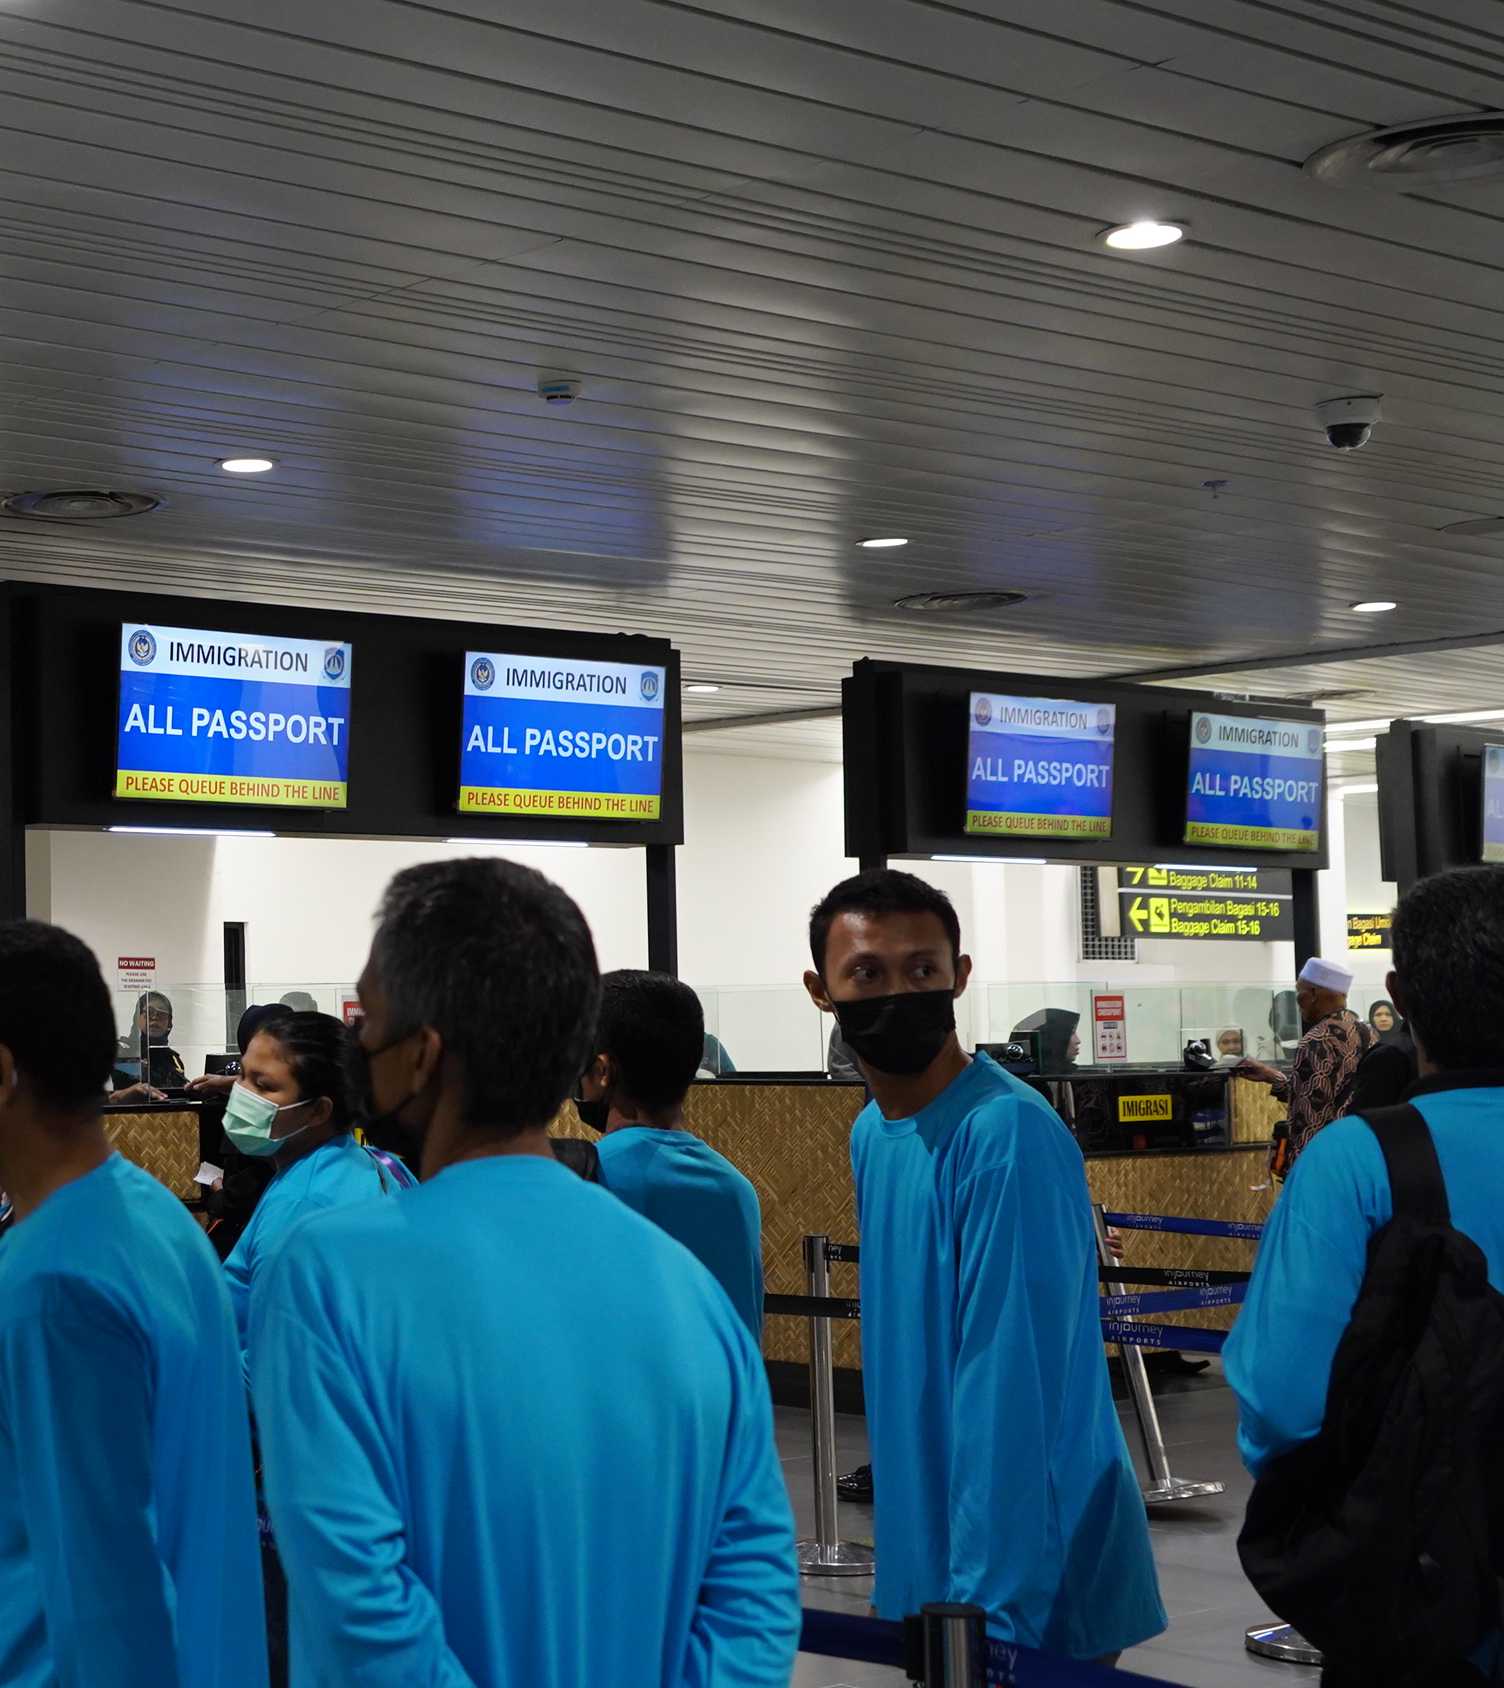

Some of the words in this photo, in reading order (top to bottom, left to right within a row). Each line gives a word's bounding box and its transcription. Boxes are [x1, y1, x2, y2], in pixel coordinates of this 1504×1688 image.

[169, 641, 308, 672] IMMIGRATION
[506, 668, 627, 694] IMMIGRATION
[124, 703, 183, 735] ALL
[191, 707, 344, 746] PASSPORT
[1000, 706, 1087, 729] IMMIGRATION
[467, 725, 517, 754] ALL
[525, 728, 659, 762] PASSPORT
[1219, 725, 1299, 748] IMMIGRATION
[971, 757, 1009, 782] ALL
[1013, 759, 1110, 788] PASSPORT
[126, 776, 175, 793] PLEASE
[178, 779, 226, 796] QUEUE
[230, 782, 280, 798] BEHIND
[284, 784, 308, 799] THE
[312, 786, 340, 801] LINE
[1191, 771, 1225, 796] ALL
[1230, 774, 1319, 803] PASSPORT
[467, 792, 509, 807] PLEASE
[513, 794, 554, 809] QUEUE
[558, 796, 602, 811] BEHIND
[605, 798, 626, 812] THE
[629, 799, 654, 813] LINE
[972, 815, 1003, 828] PLEASE
[1005, 816, 1035, 829] QUEUE
[1037, 818, 1069, 831] BEHIND
[1071, 819, 1087, 832] THE
[1089, 820, 1107, 833] LINE
[1191, 826, 1219, 839] PLEASE
[1221, 828, 1249, 841] QUEUE
[1251, 830, 1280, 843] BEHIND
[1282, 832, 1296, 844] THE
[1169, 871, 1208, 890] Baggage
[1209, 872, 1233, 889] Claim
[1235, 875, 1258, 889] 11-14
[1170, 898, 1225, 917] Pengambilan
[1226, 900, 1254, 918] Bagasi
[1256, 902, 1280, 917] 15-16
[1171, 918, 1209, 936] Baggage
[1211, 918, 1235, 935] Claim
[1236, 920, 1260, 935] 15-16
[1122, 1099, 1168, 1117] IMIGRASI
[1111, 1336, 1161, 1345] AIRPORTS
